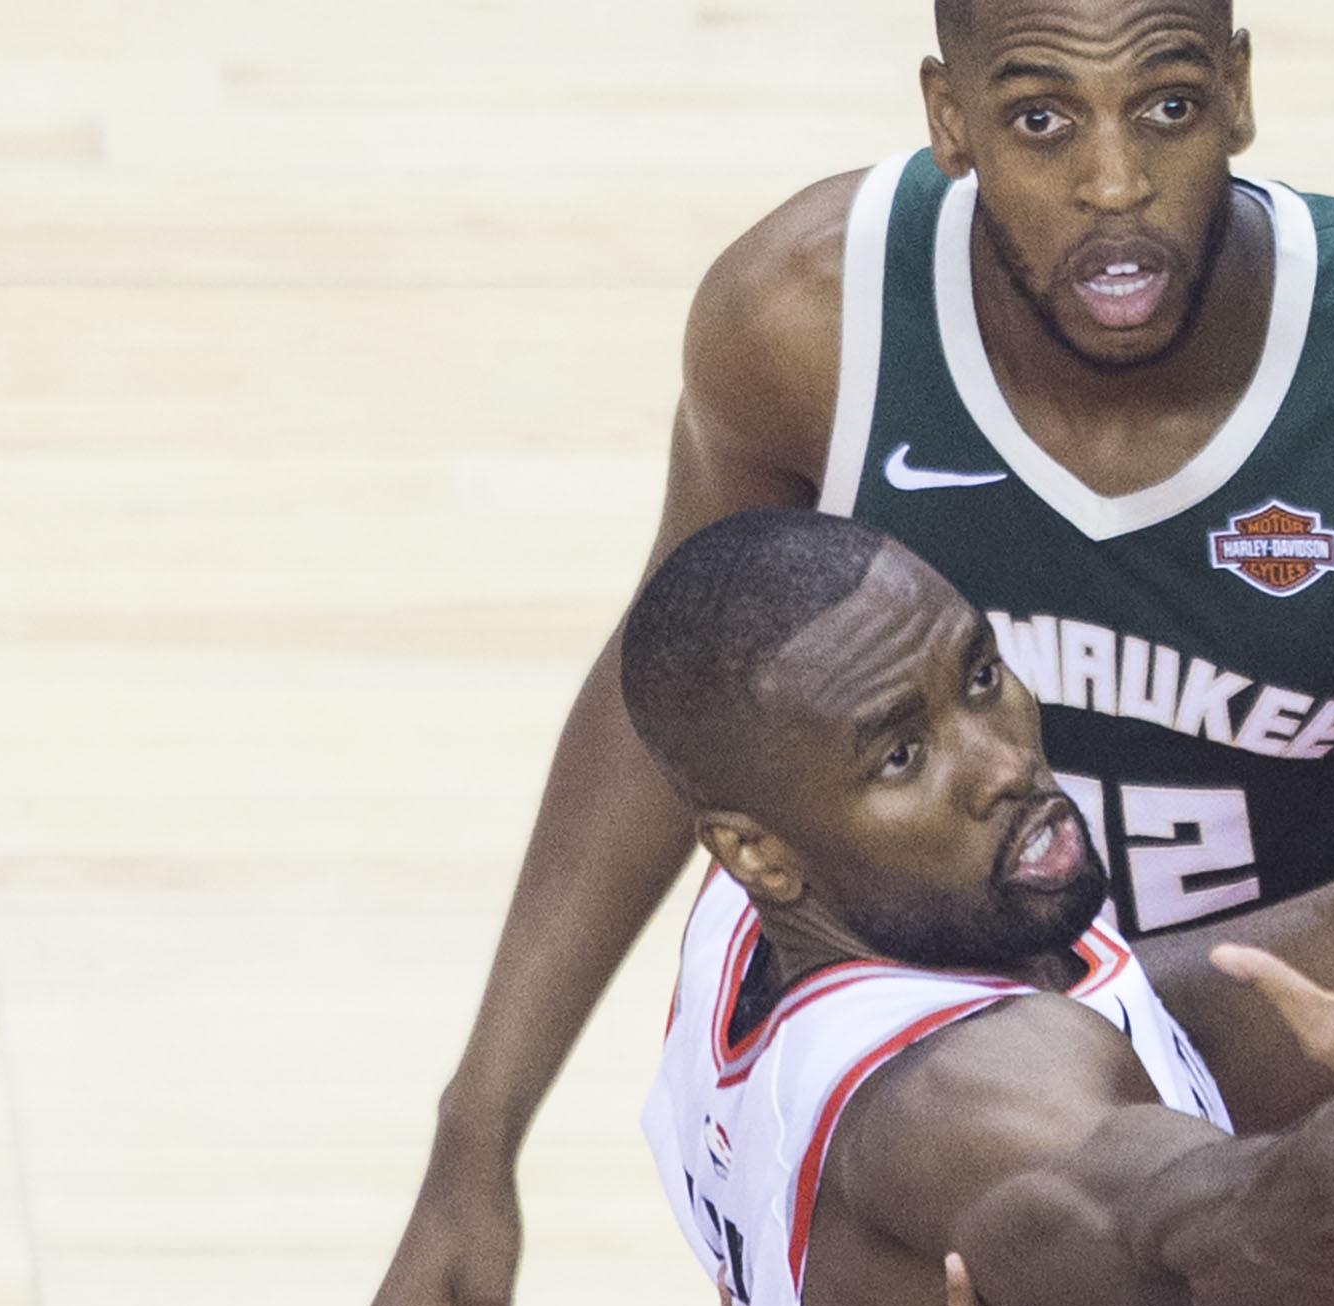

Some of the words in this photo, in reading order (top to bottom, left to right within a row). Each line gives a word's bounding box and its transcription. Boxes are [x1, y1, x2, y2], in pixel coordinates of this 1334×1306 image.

[1247, 516, 1305, 534] MOTOR
[1222, 539, 1330, 560] HARLEY-DAVIDSON
[1249, 562, 1308, 586] CYCLES
